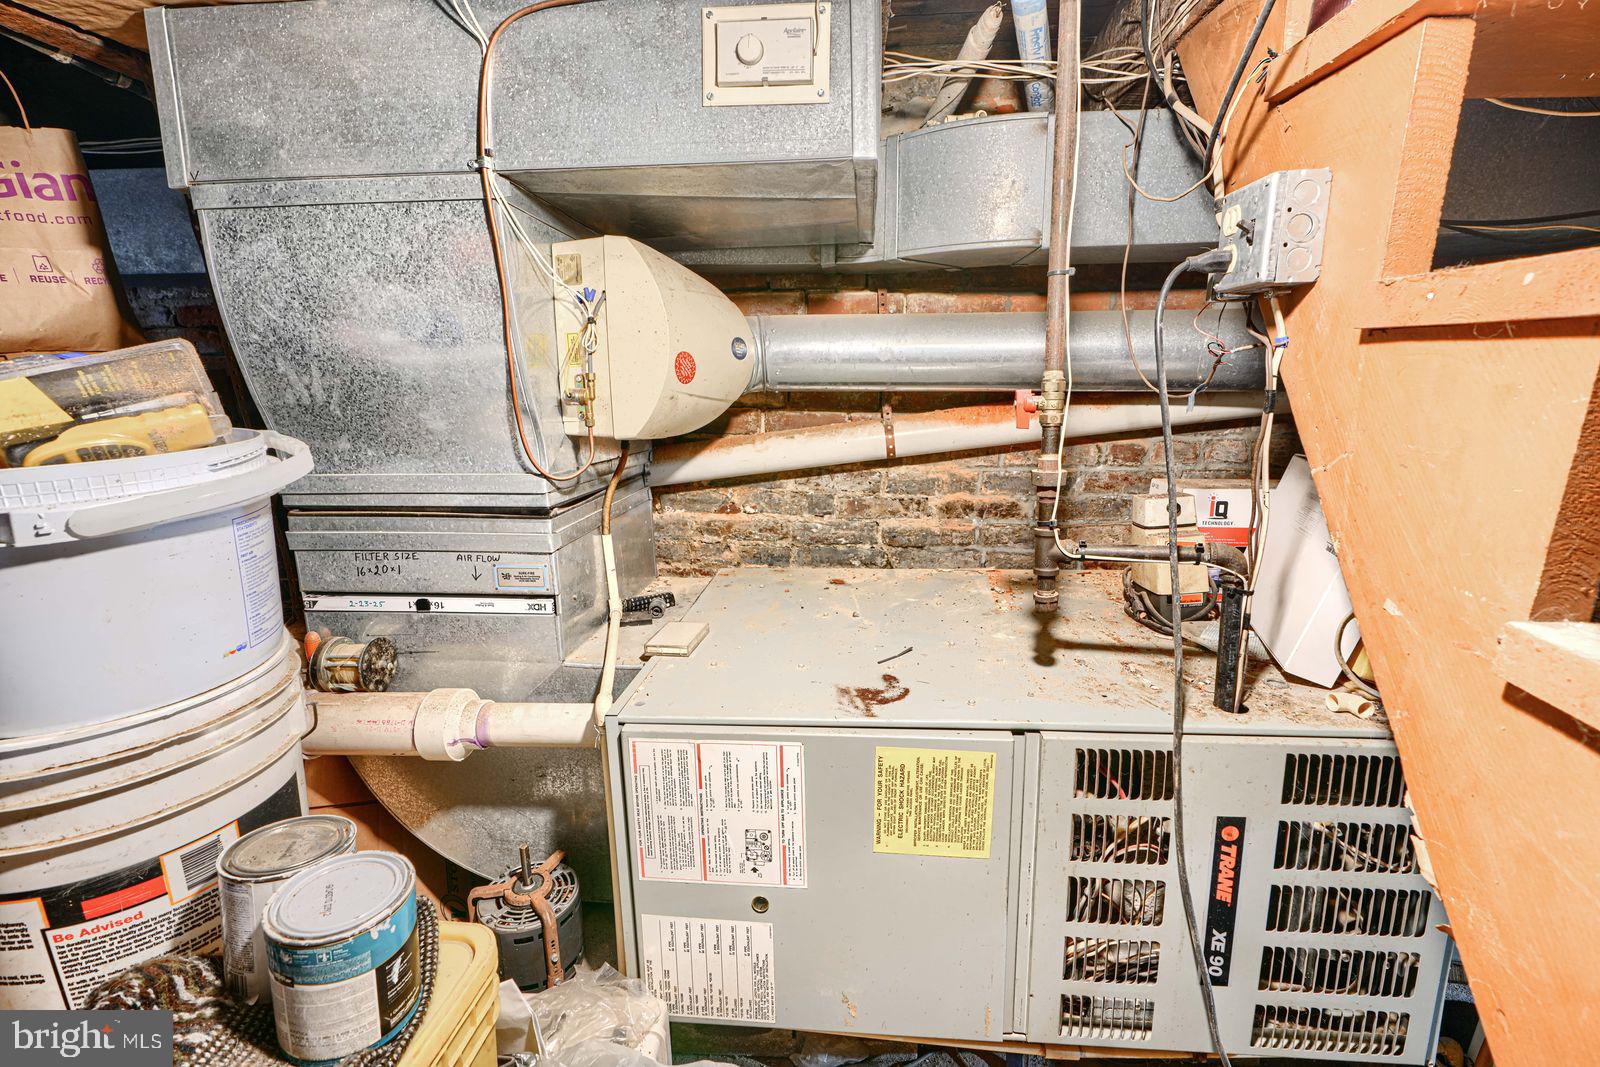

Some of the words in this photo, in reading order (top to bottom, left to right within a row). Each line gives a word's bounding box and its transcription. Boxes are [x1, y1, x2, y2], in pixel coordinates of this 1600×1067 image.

[30, 275, 66, 284] REUSE
[354, 552, 390, 561] FILTER
[394, 552, 420, 560] SIZE
[456, 554, 474, 562] AIR
[476, 554, 500, 562] FLOW
[349, 600, 386, 608] 2-23-25
[527, 602, 547, 611] HDX
[1216, 844, 1238, 902] TRANE
[52, 931, 74, 943] Be
[79, 910, 144, 938] Advised
[1210, 928, 1227, 954] XE
[1208, 956, 1224, 977] 90
